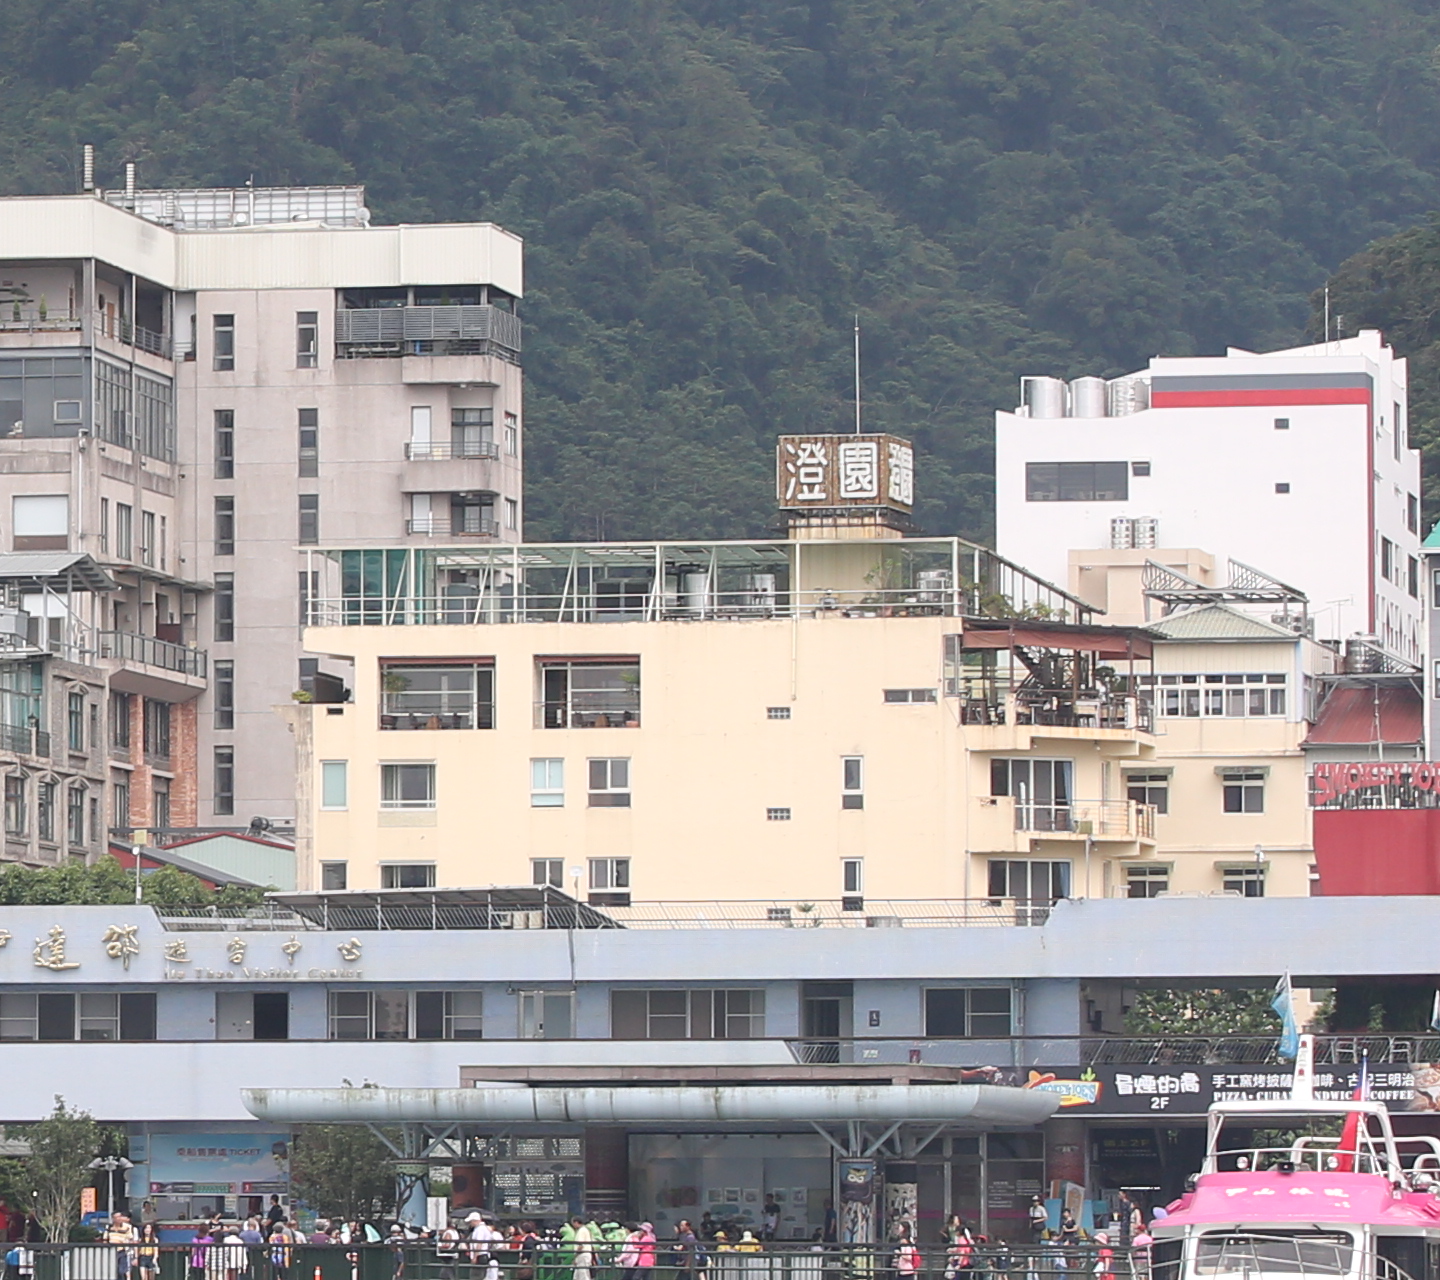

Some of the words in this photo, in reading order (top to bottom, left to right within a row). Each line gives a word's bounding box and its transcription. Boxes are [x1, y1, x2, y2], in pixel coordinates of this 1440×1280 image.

[785, 441, 878, 500] 澄園
[1314, 762, 1403, 806] SMOKEY
[1116, 1072, 1201, 1095] 冒煙的喬
[1151, 1096, 1170, 1110] 2F
[1256, 1091, 1292, 1102] CUBA
[229, 1149, 262, 1157] TICKET
